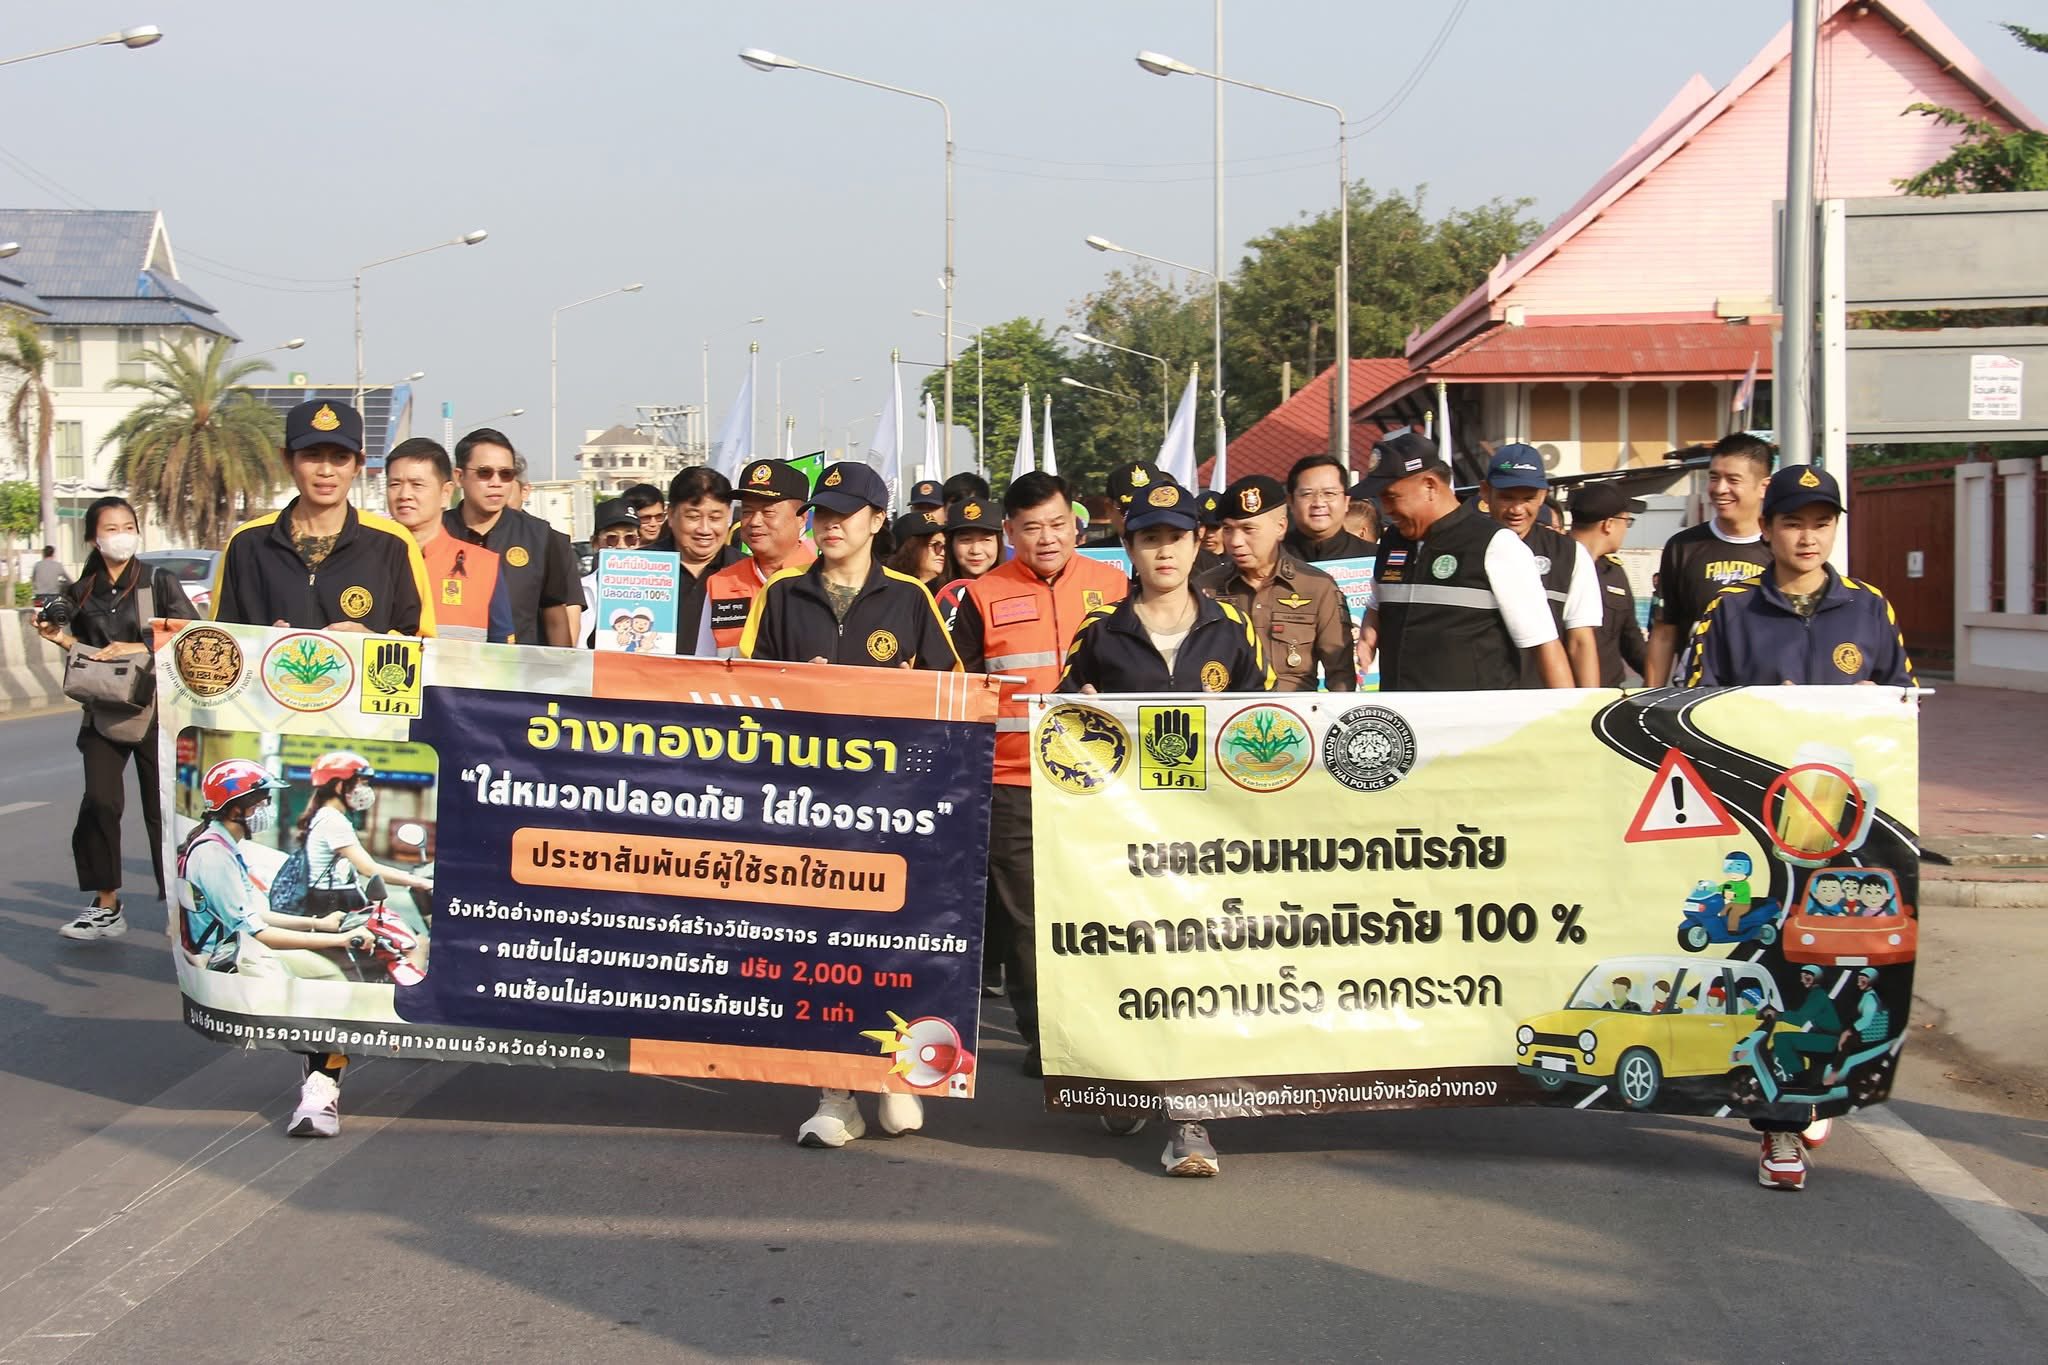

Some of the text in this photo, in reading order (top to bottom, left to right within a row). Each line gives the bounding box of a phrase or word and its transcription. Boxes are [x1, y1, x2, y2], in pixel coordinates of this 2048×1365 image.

[527, 702, 898, 774] อ่างทองบ้านเรา
[1325, 735, 1387, 790] ROYAL THAI POLICE
[460, 763, 954, 836] “ใส่หมวกปลอดภัย ใส่ใจจราจร”
[1152, 770, 1200, 789] ปภ.
[531, 840, 886, 893] ประชาสัมพันธ์ผู้ใช้รถใช้ถนน
[1127, 823, 1507, 878] เขตสวมหมวกนิรภัย
[448, 897, 968, 954] จังหวัดอ่างทองร่วมรณรงค์สร้างวินัยจราจร สวมหมวกนิรภัย
[1051, 897, 1588, 956] และคาดเข็มขัดนิรภัย 100 %
[496, 936, 913, 989] คนขับไม่สวมหมวกนิรภัย ปรับ 2,000 บาท
[493, 977, 856, 1023] คนซ้อนไม่สวมหมวกนิรภัยปรับ 2 เท่า
[1118, 965, 1503, 1021] ลดความเร็ว ลดกระจก
[1058, 1075, 1498, 1109] ศูนย์อำนวยการความปลอดภัยทางถนนจังหวัดอ่างทอง
